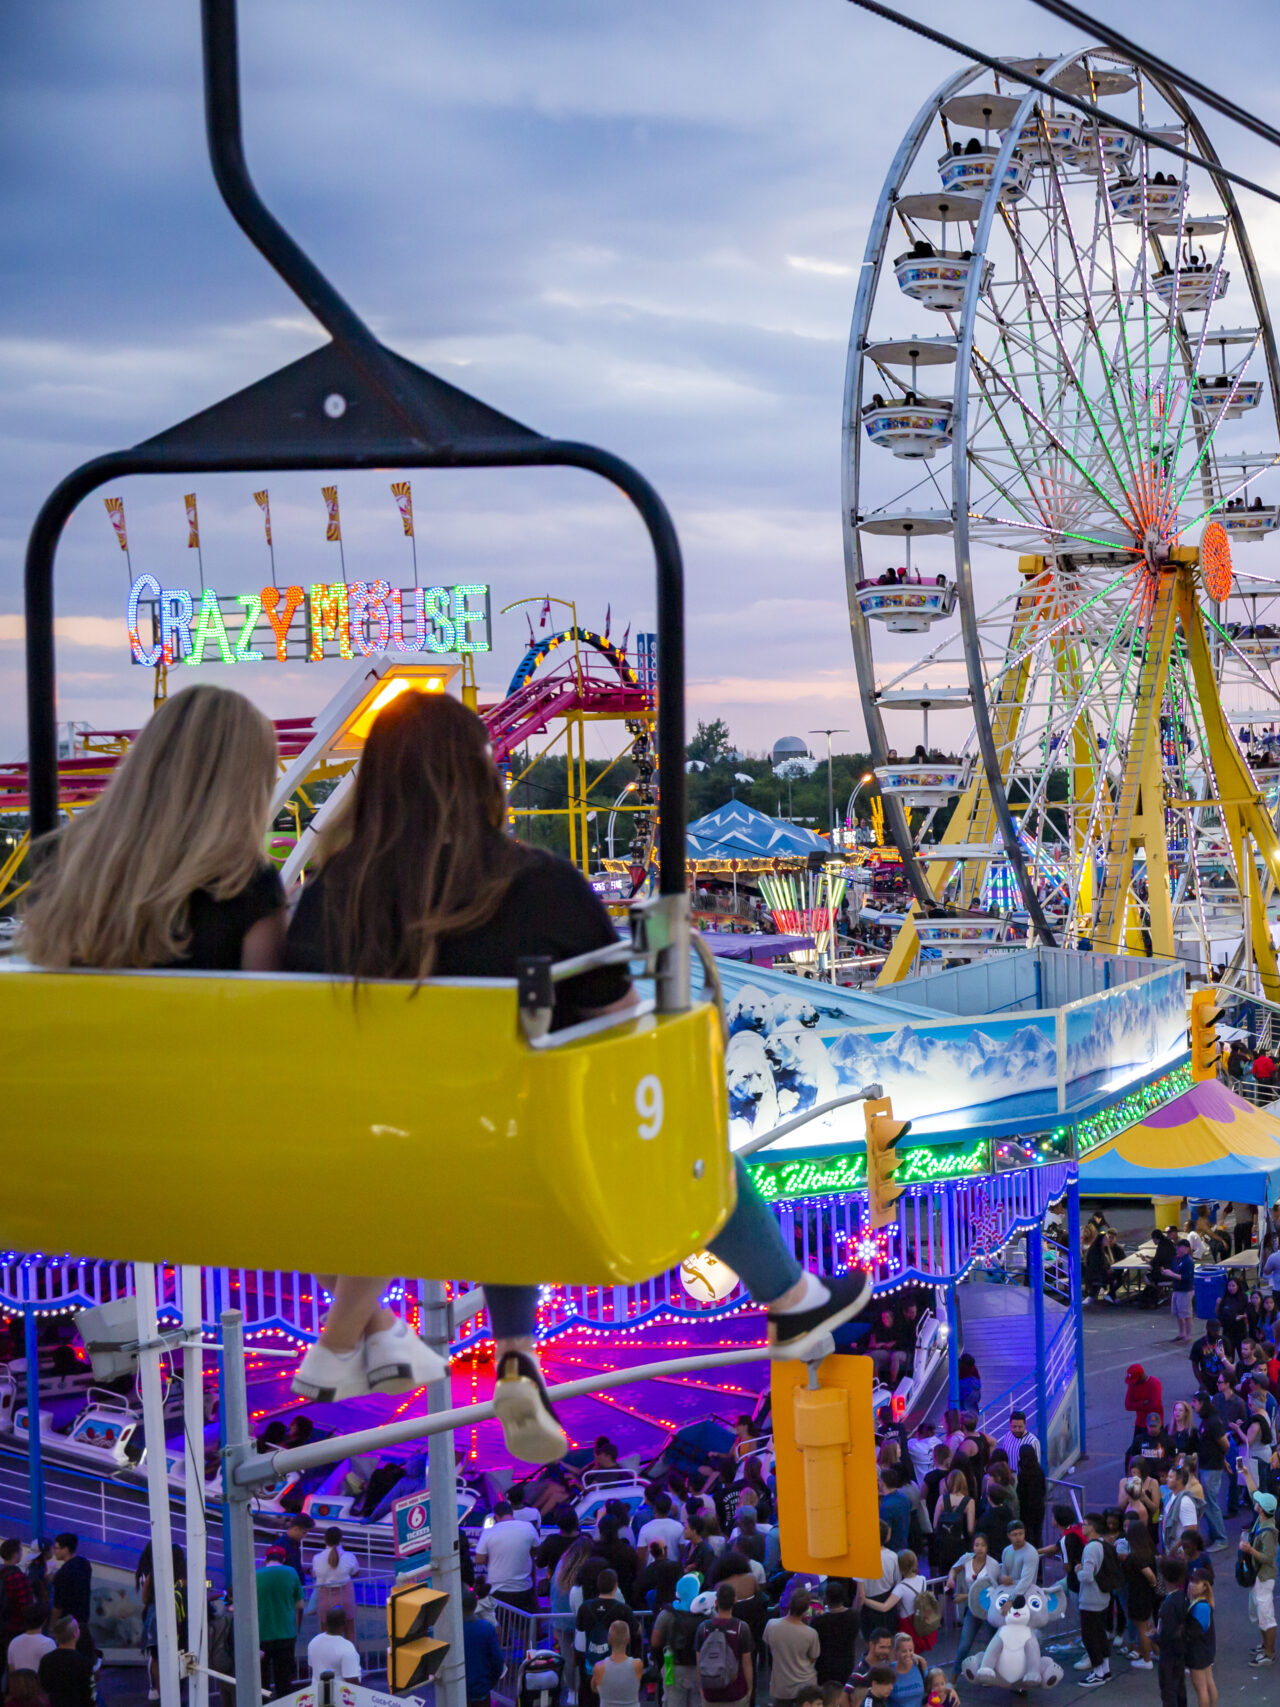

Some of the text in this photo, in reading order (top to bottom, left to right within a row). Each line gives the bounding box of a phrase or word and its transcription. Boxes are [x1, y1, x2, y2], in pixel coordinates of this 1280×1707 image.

[127, 573, 490, 666] CRAZY MOUSE
[635, 1073, 664, 1141] 9
[406, 1525, 430, 1541] TICKETS
[411, 1507, 423, 1528] 6
